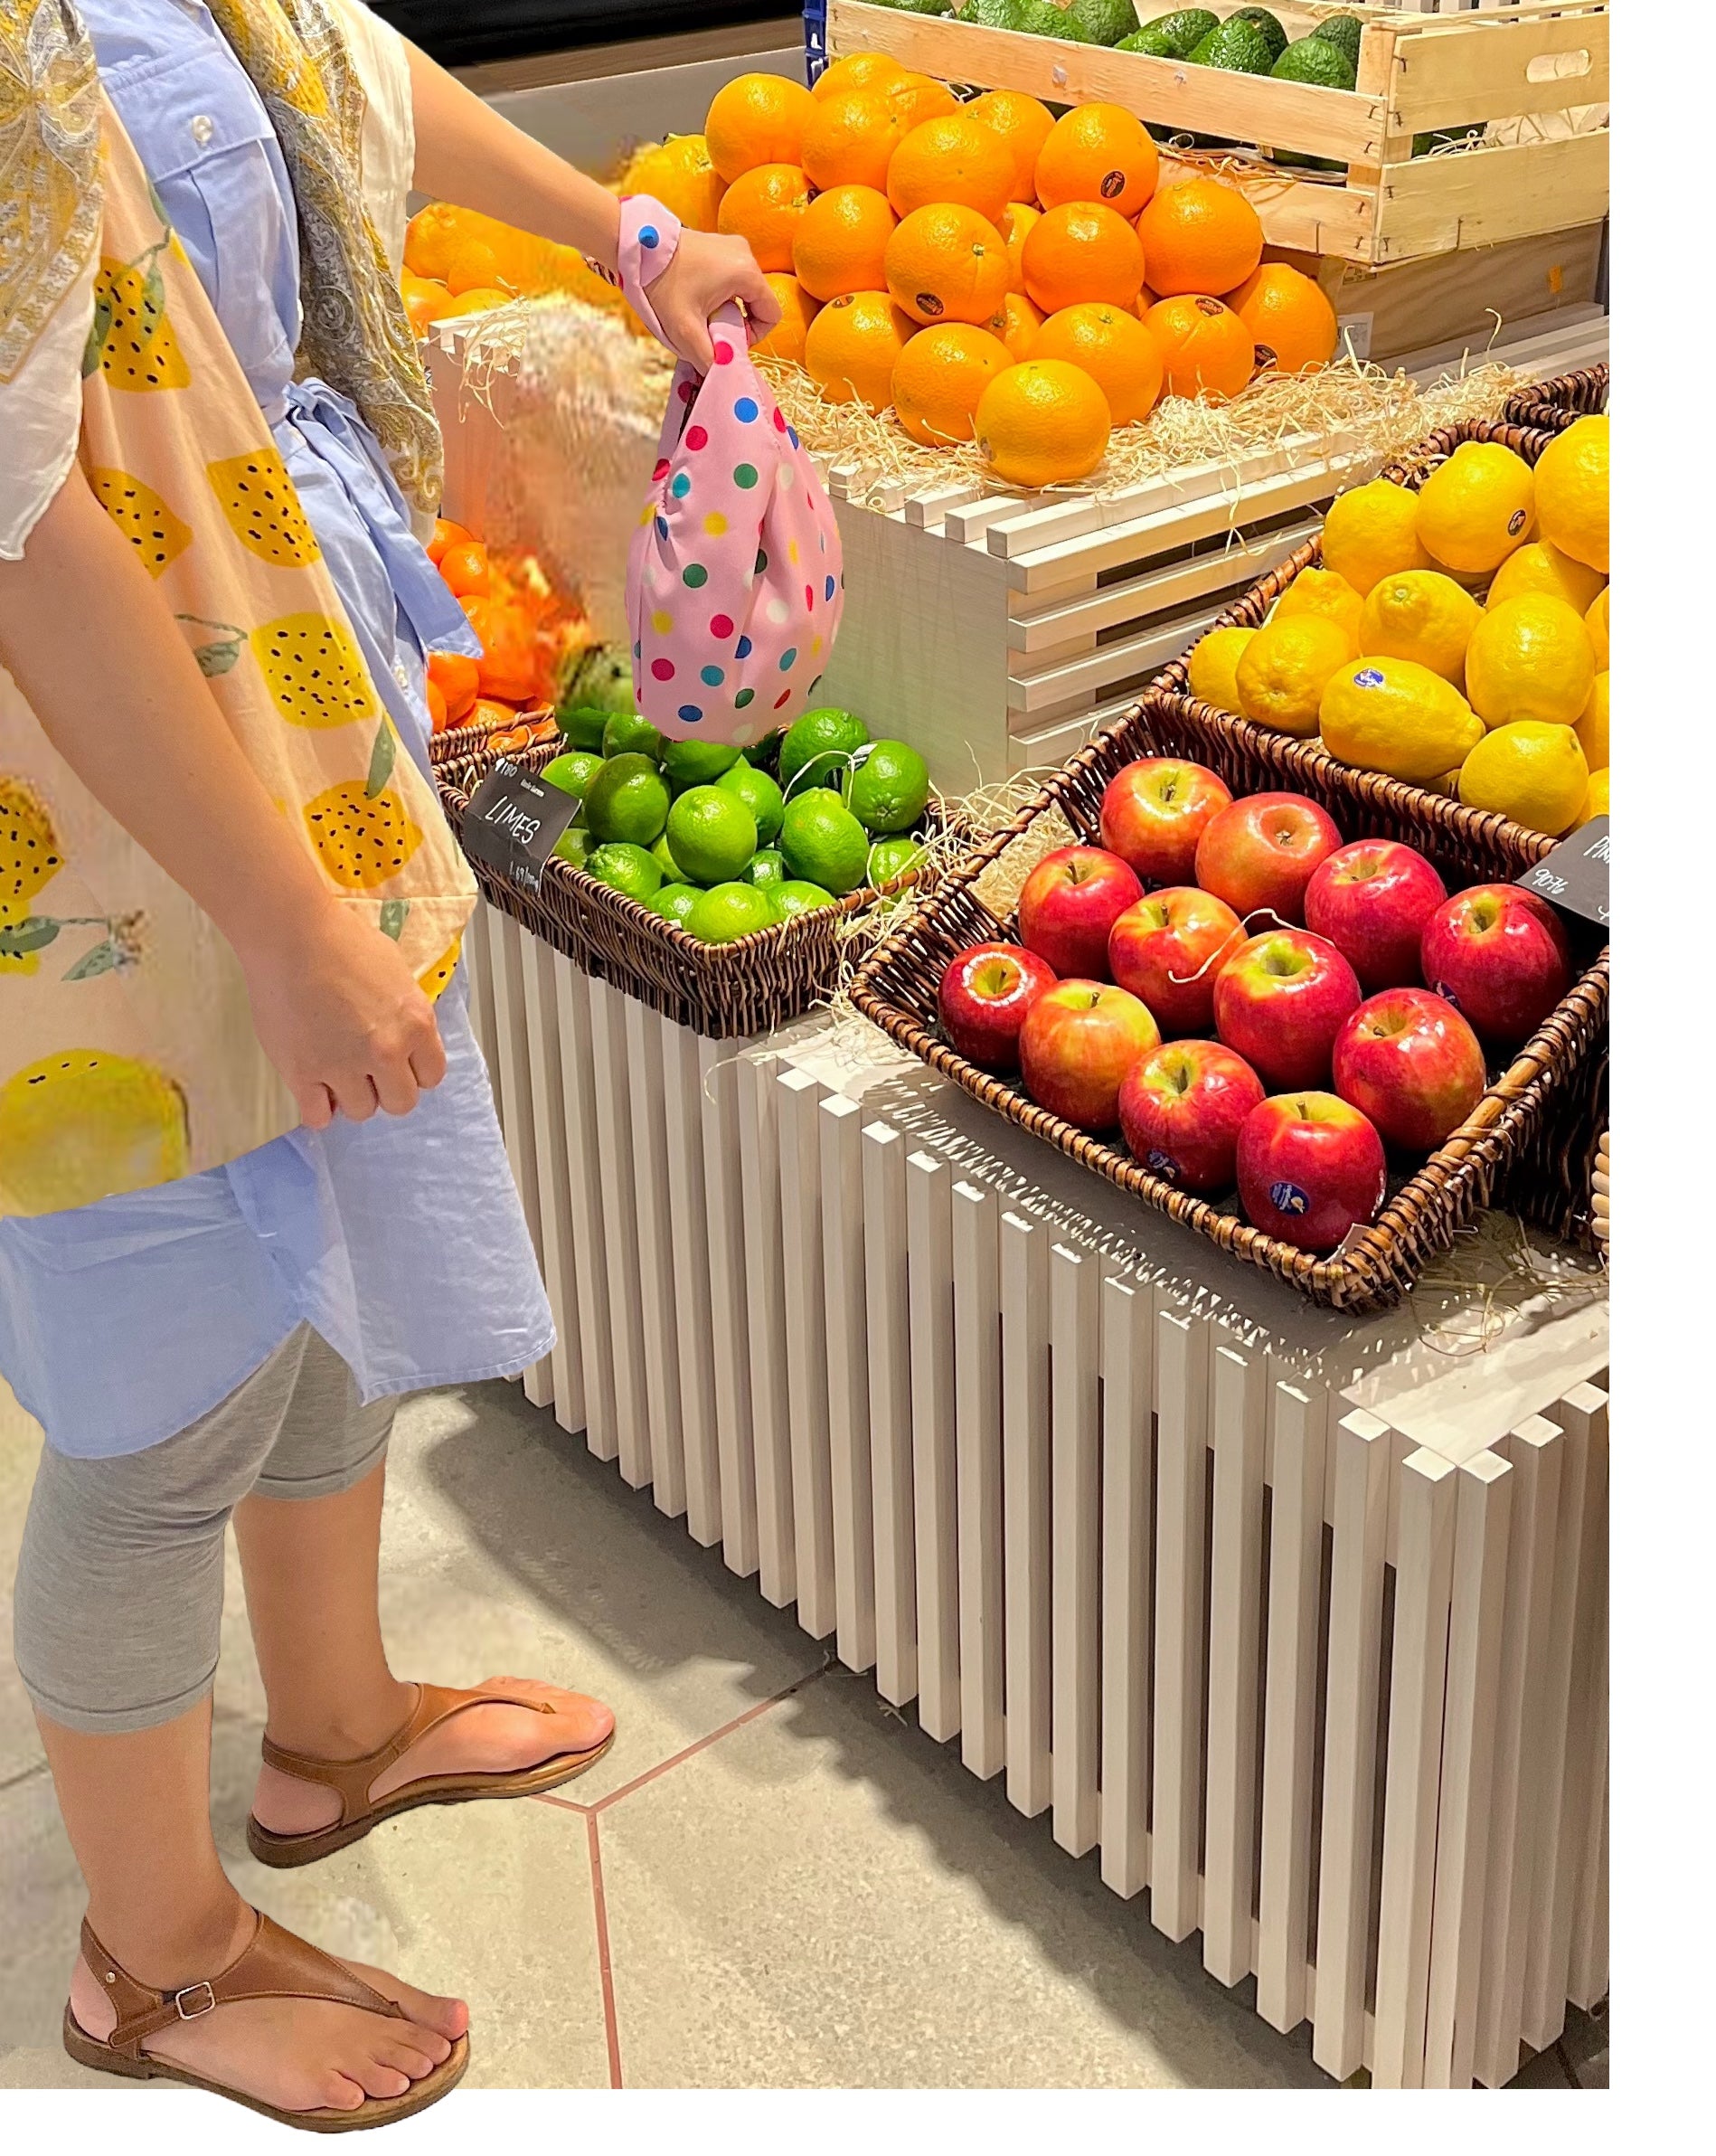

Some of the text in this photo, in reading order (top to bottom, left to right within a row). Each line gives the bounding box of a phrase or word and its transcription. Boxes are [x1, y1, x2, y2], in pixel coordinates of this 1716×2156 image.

[485, 796, 542, 845] LIMES
[1582, 835, 1609, 865] PIN
[1532, 868, 1570, 894] 9076
